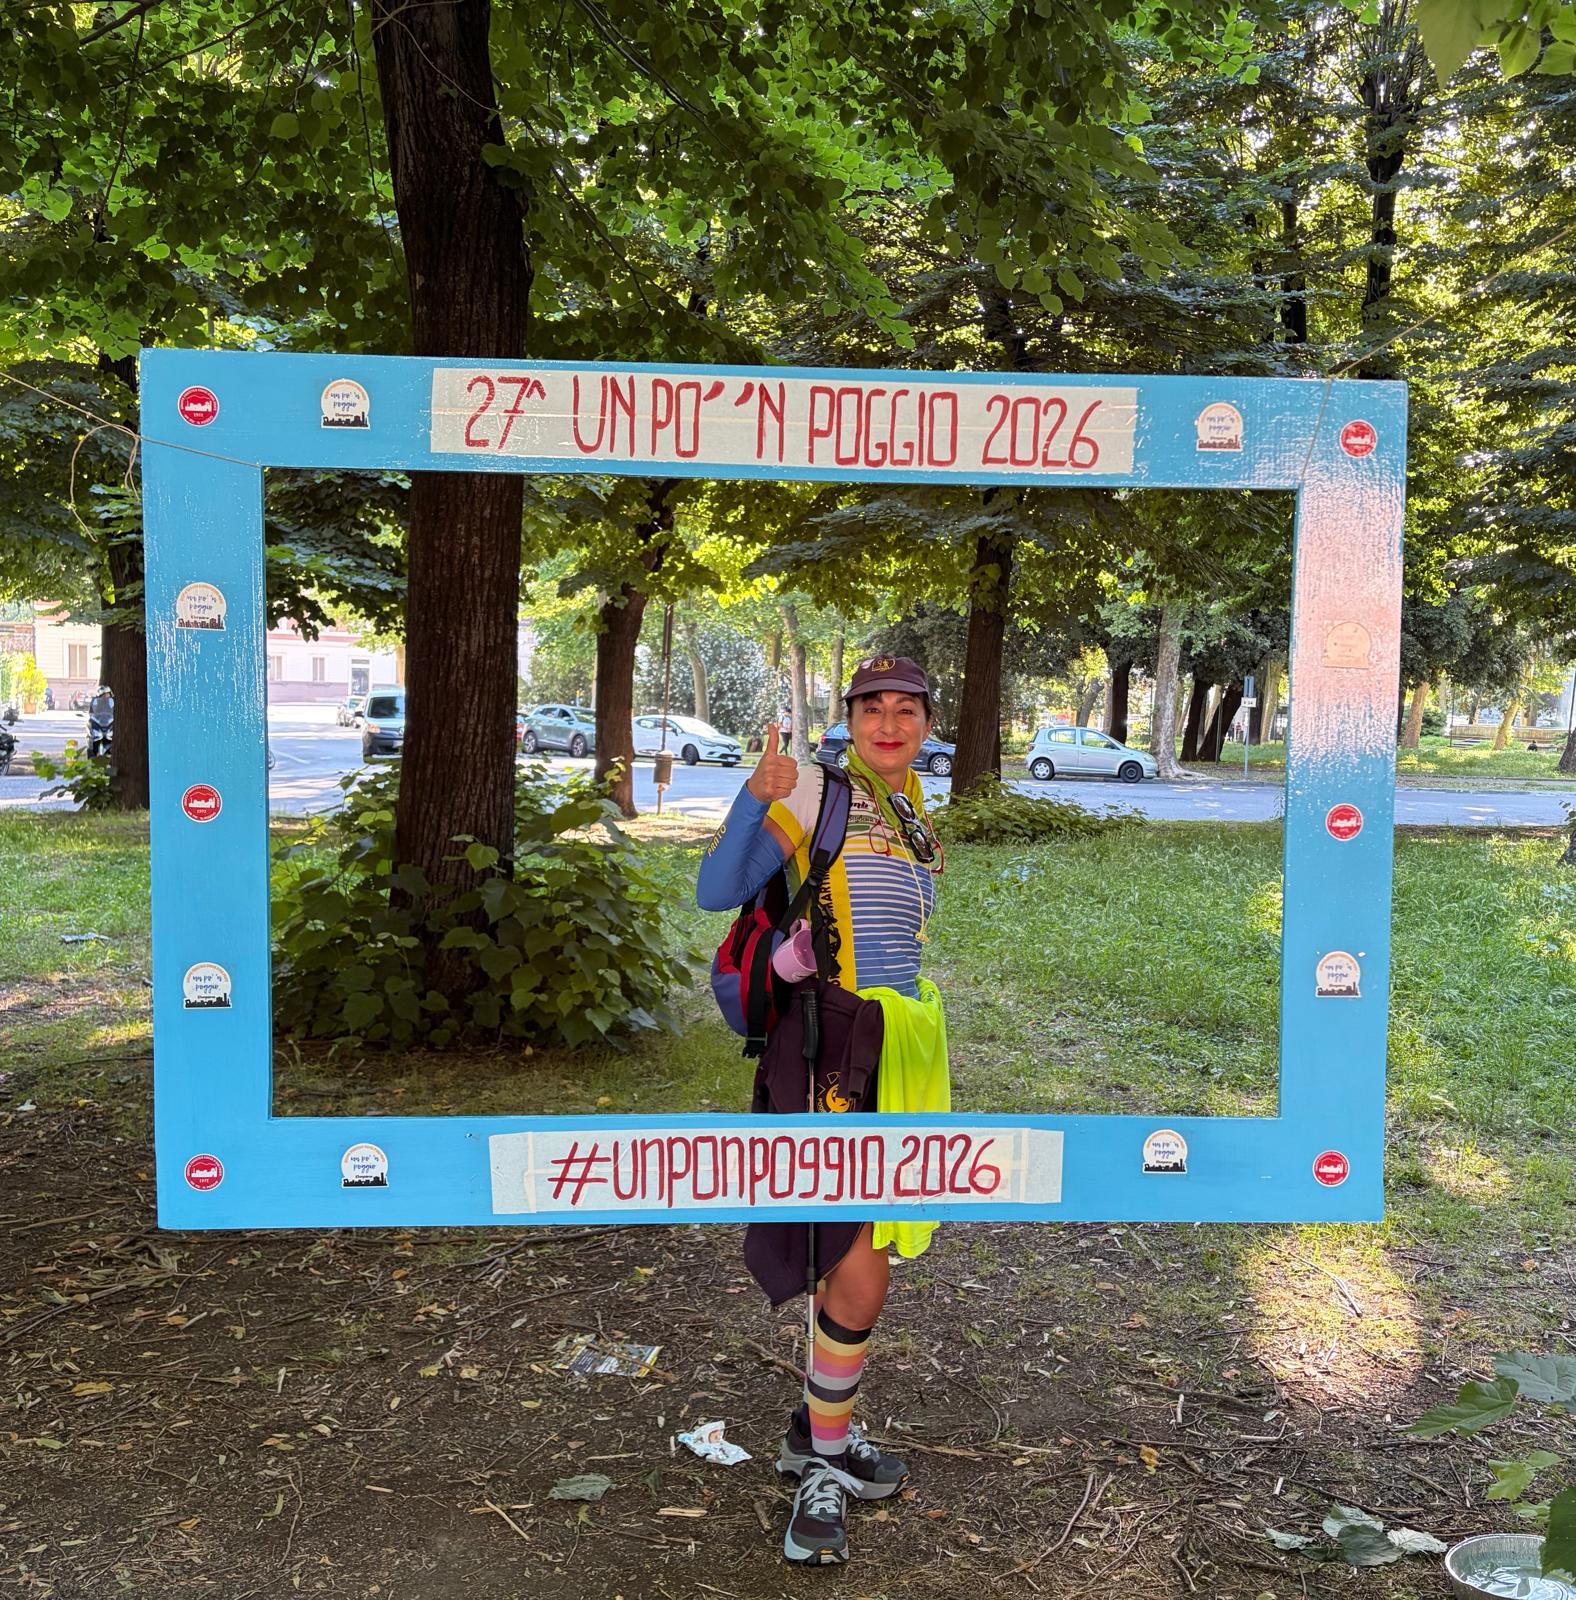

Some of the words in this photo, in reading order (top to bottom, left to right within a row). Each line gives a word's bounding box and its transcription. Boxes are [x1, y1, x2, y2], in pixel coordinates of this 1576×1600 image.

[573, 375, 636, 457] UN
[808, 385, 958, 468] POGGIO
[982, 395, 1102, 469] 2026
